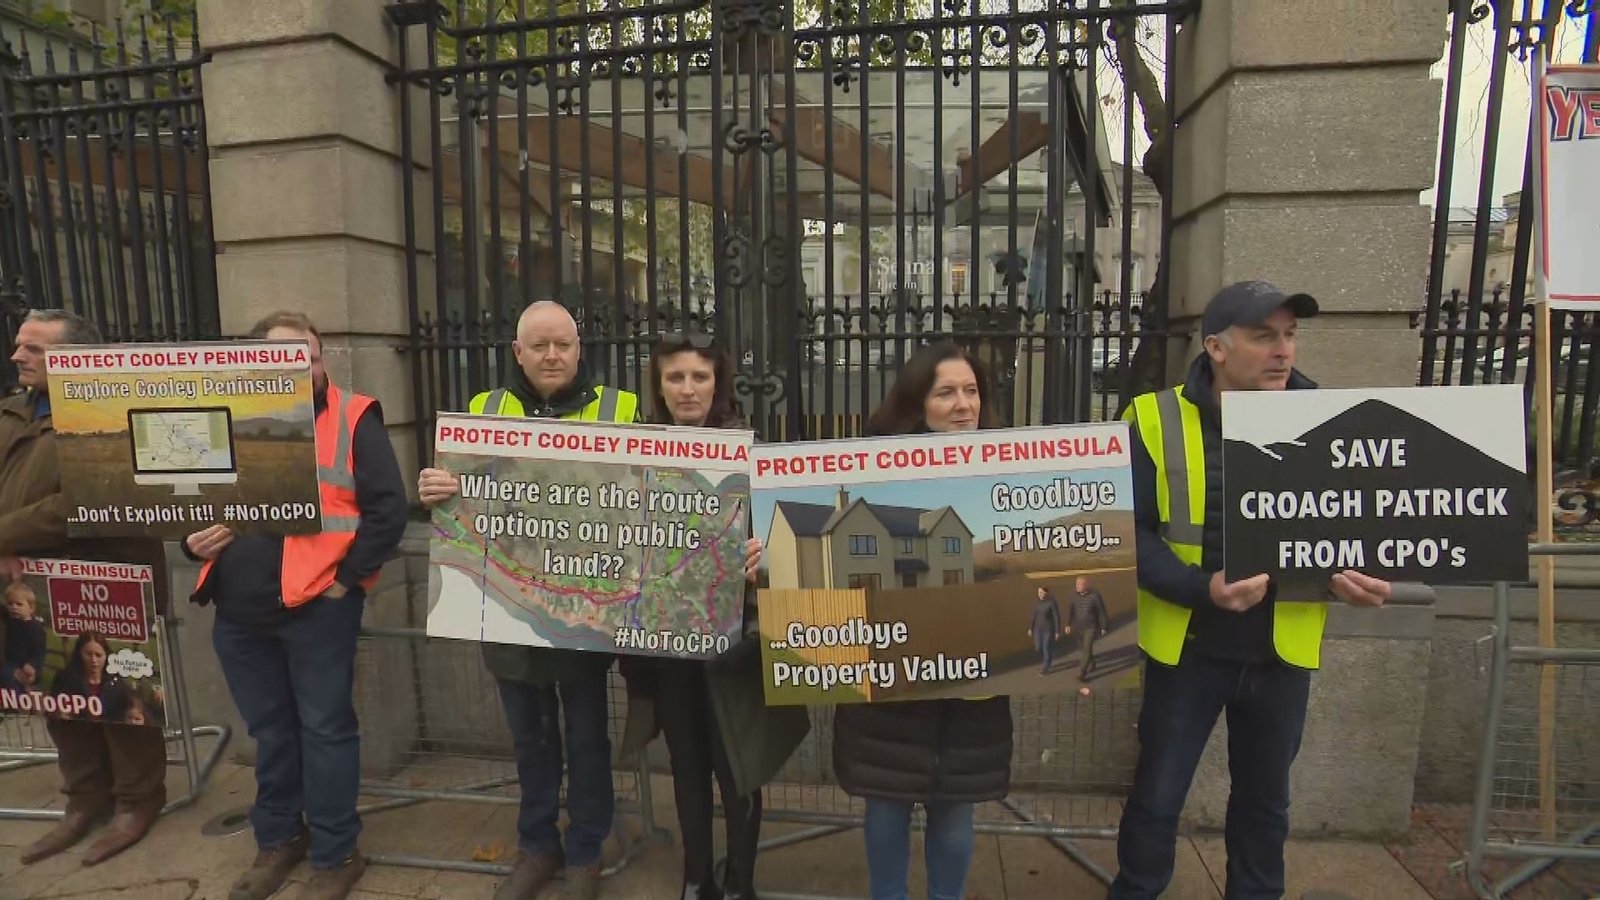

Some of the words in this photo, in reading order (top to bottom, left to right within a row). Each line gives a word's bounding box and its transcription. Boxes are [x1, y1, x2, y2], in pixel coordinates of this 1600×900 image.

[49, 353, 125, 368] PROTECT
[130, 351, 198, 367] COOLEY
[204, 348, 306, 365] PENINSULA
[63, 379, 130, 402] Explore
[135, 377, 198, 400] Cooley
[202, 375, 296, 397] Peninsula
[439, 426, 532, 447] PROTECT
[538, 433, 621, 454] COOLEY
[626, 439, 748, 462] PENINSULA
[756, 452, 869, 477] PROTECT
[876, 446, 974, 470] COOLEY
[982, 436, 1123, 462] PENINSULA
[1330, 438, 1406, 469] SAVE
[460, 474, 541, 502] Where
[548, 483, 591, 507] are
[599, 483, 641, 511] the
[648, 489, 721, 516] route
[991, 477, 1116, 512] Goodbye
[1240, 489, 1363, 519] CROAGH
[1376, 487, 1509, 517] PATRICK
[67, 505, 121, 523] ...Don't
[125, 504, 184, 525] Exploit
[189, 503, 214, 522] it!!
[223, 503, 316, 522] #NoToCPO
[474, 512, 570, 541] options
[578, 523, 610, 544] on
[617, 521, 701, 550] public
[993, 520, 1121, 553] Privacy...
[543, 549, 625, 579] land??
[1278, 539, 1367, 569] FROM
[1377, 537, 1467, 568] CPO's
[60, 564, 150, 580] PENINSULA
[80, 583, 109, 601] NO
[57, 602, 138, 619] PLANNING
[57, 617, 142, 637] PERMISSION
[615, 627, 730, 654] #NoToCPO
[769, 616, 909, 650] ...Goodbye
[773, 657, 897, 690] Property
[902, 652, 989, 682] Value!
